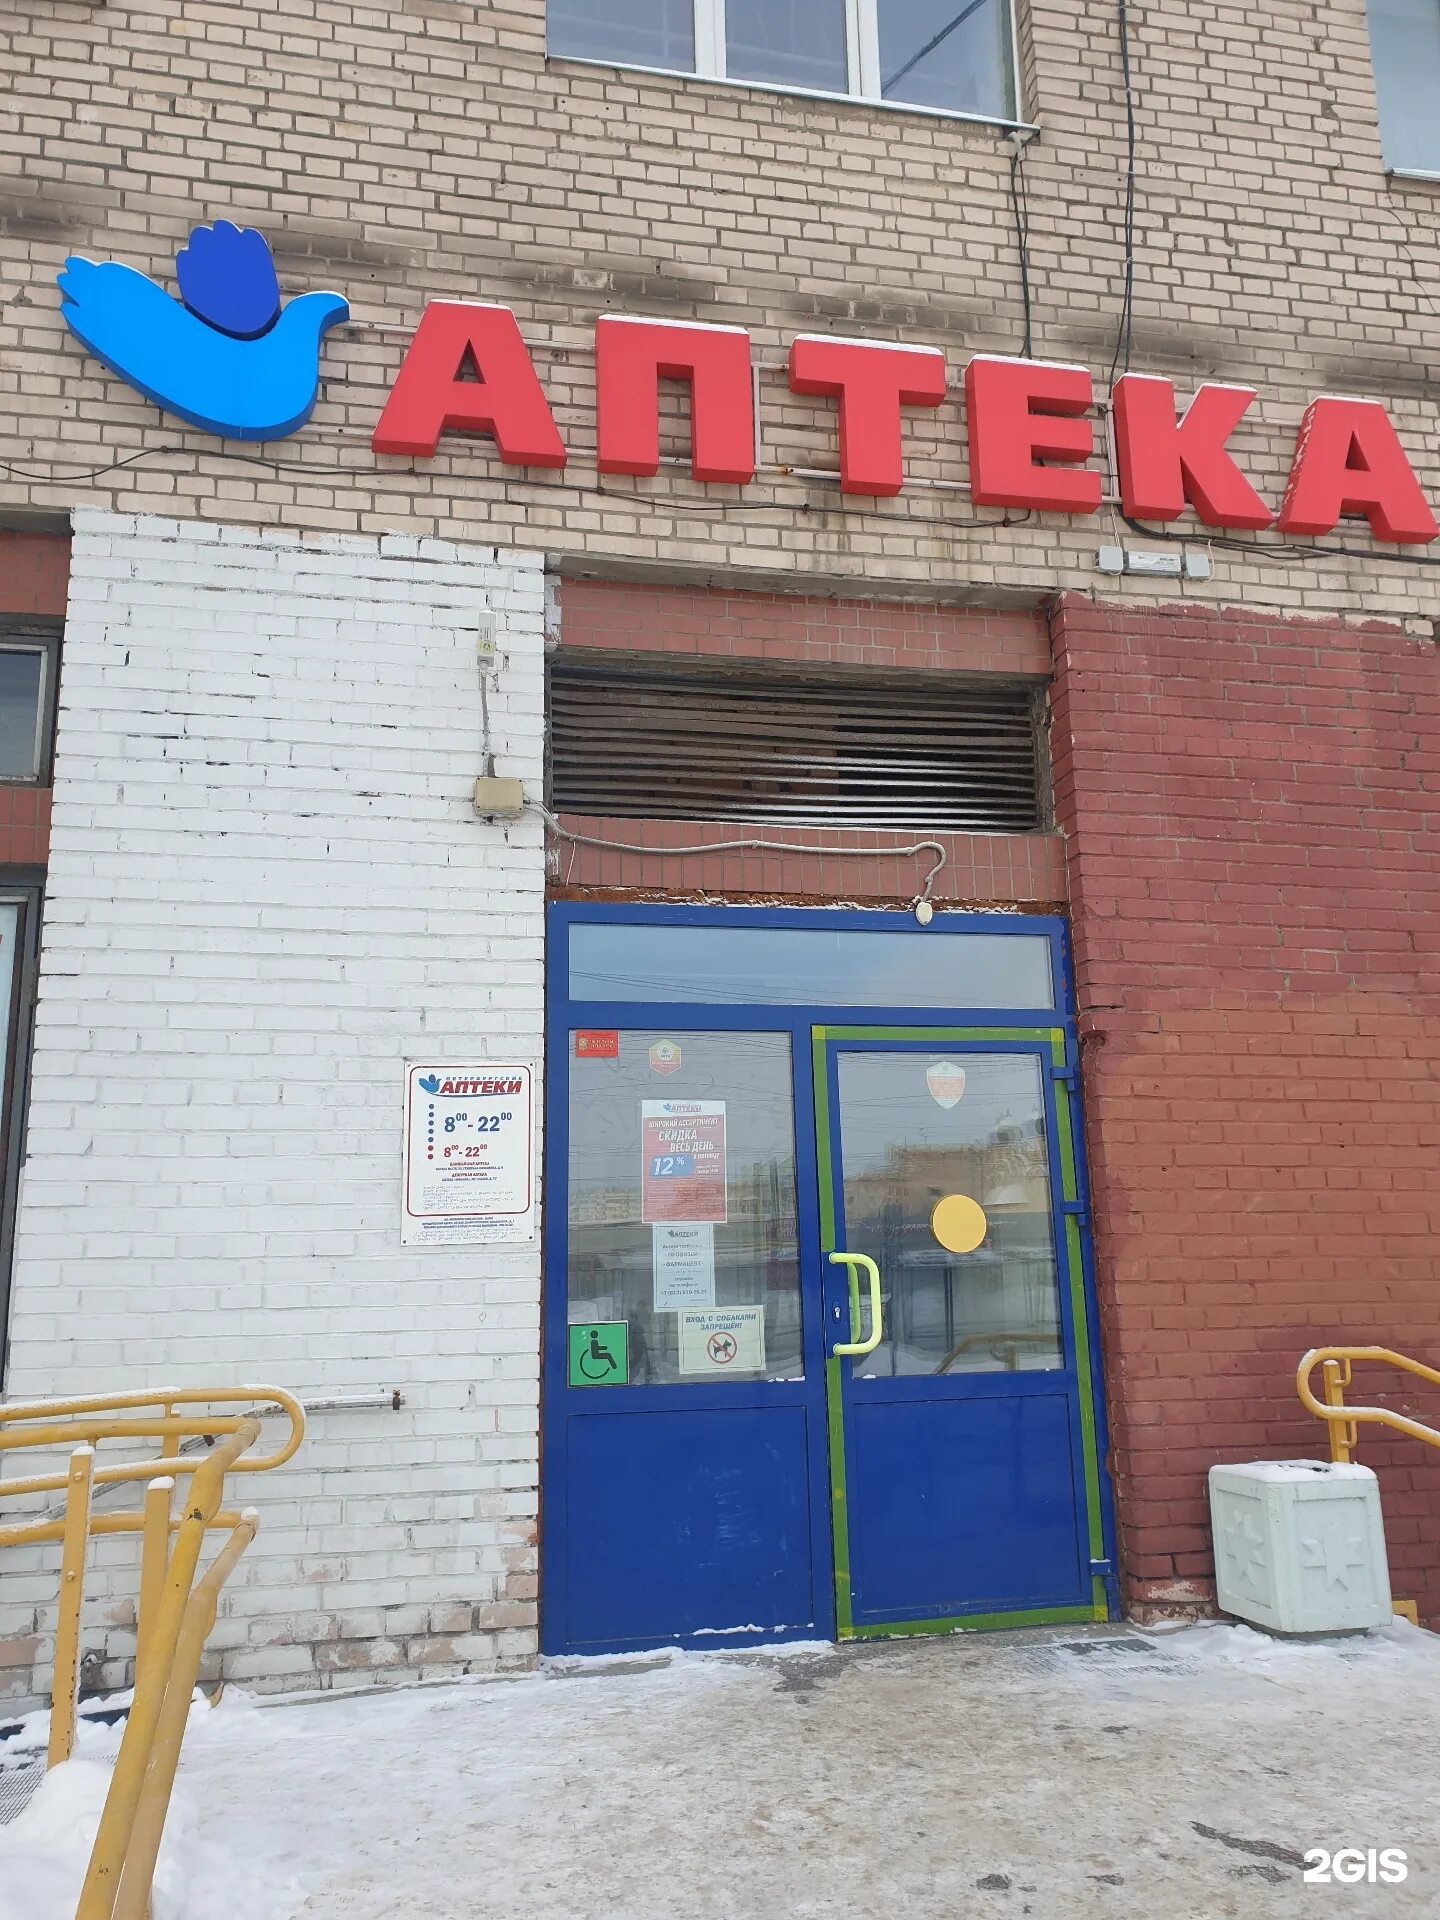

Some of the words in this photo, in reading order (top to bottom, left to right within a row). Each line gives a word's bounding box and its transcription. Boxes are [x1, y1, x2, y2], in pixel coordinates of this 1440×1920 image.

[373, 299, 1435, 546] АПТЕКА
[440, 1081, 523, 1094] АПТЕКИ
[648, 1119, 678, 1128] ШИРОКИЙ
[678, 1117, 719, 1127] АССОРТИМЕНТ
[658, 1129, 698, 1142] СКИДКА
[670, 1142, 691, 1153] ВЕСЬ
[692, 1141, 714, 1153] ДЕНЬ
[716, 1313, 757, 1322] СОБАКАМИ
